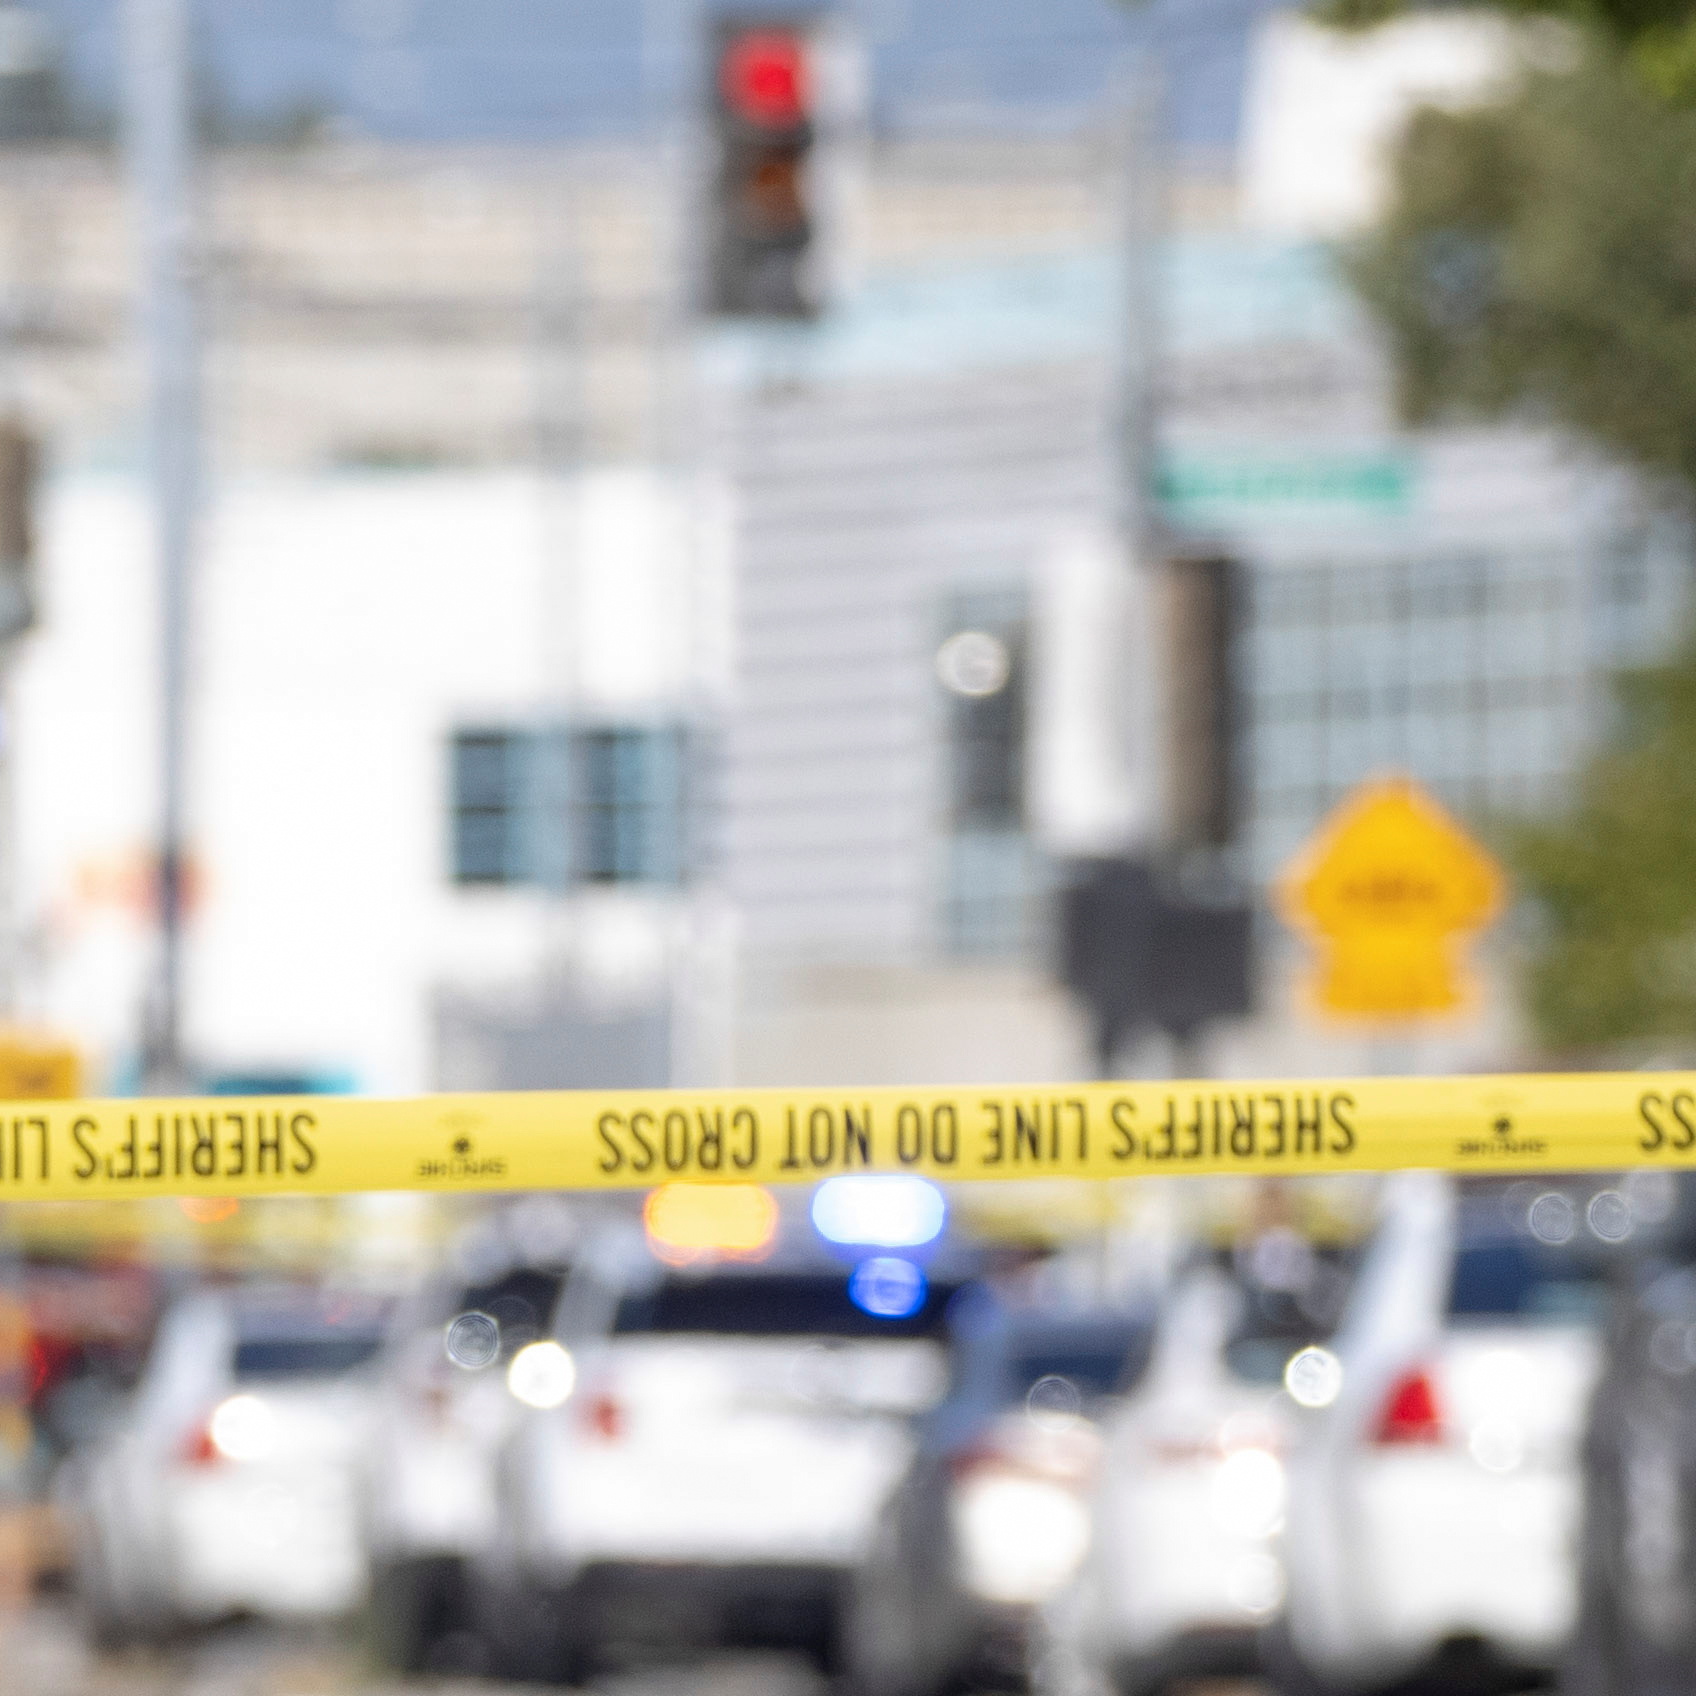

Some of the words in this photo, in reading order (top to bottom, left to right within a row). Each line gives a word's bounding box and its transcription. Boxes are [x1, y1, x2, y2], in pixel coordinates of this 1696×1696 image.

[73, 1113, 317, 1179] SHERIFF'S
[599, 1112, 759, 1174] CROSS
[780, 1109, 871, 1170] NOT
[896, 1106, 957, 1166] DO
[984, 1102, 1088, 1165] LINE
[1113, 1097, 1356, 1161] SHERIFF'S
